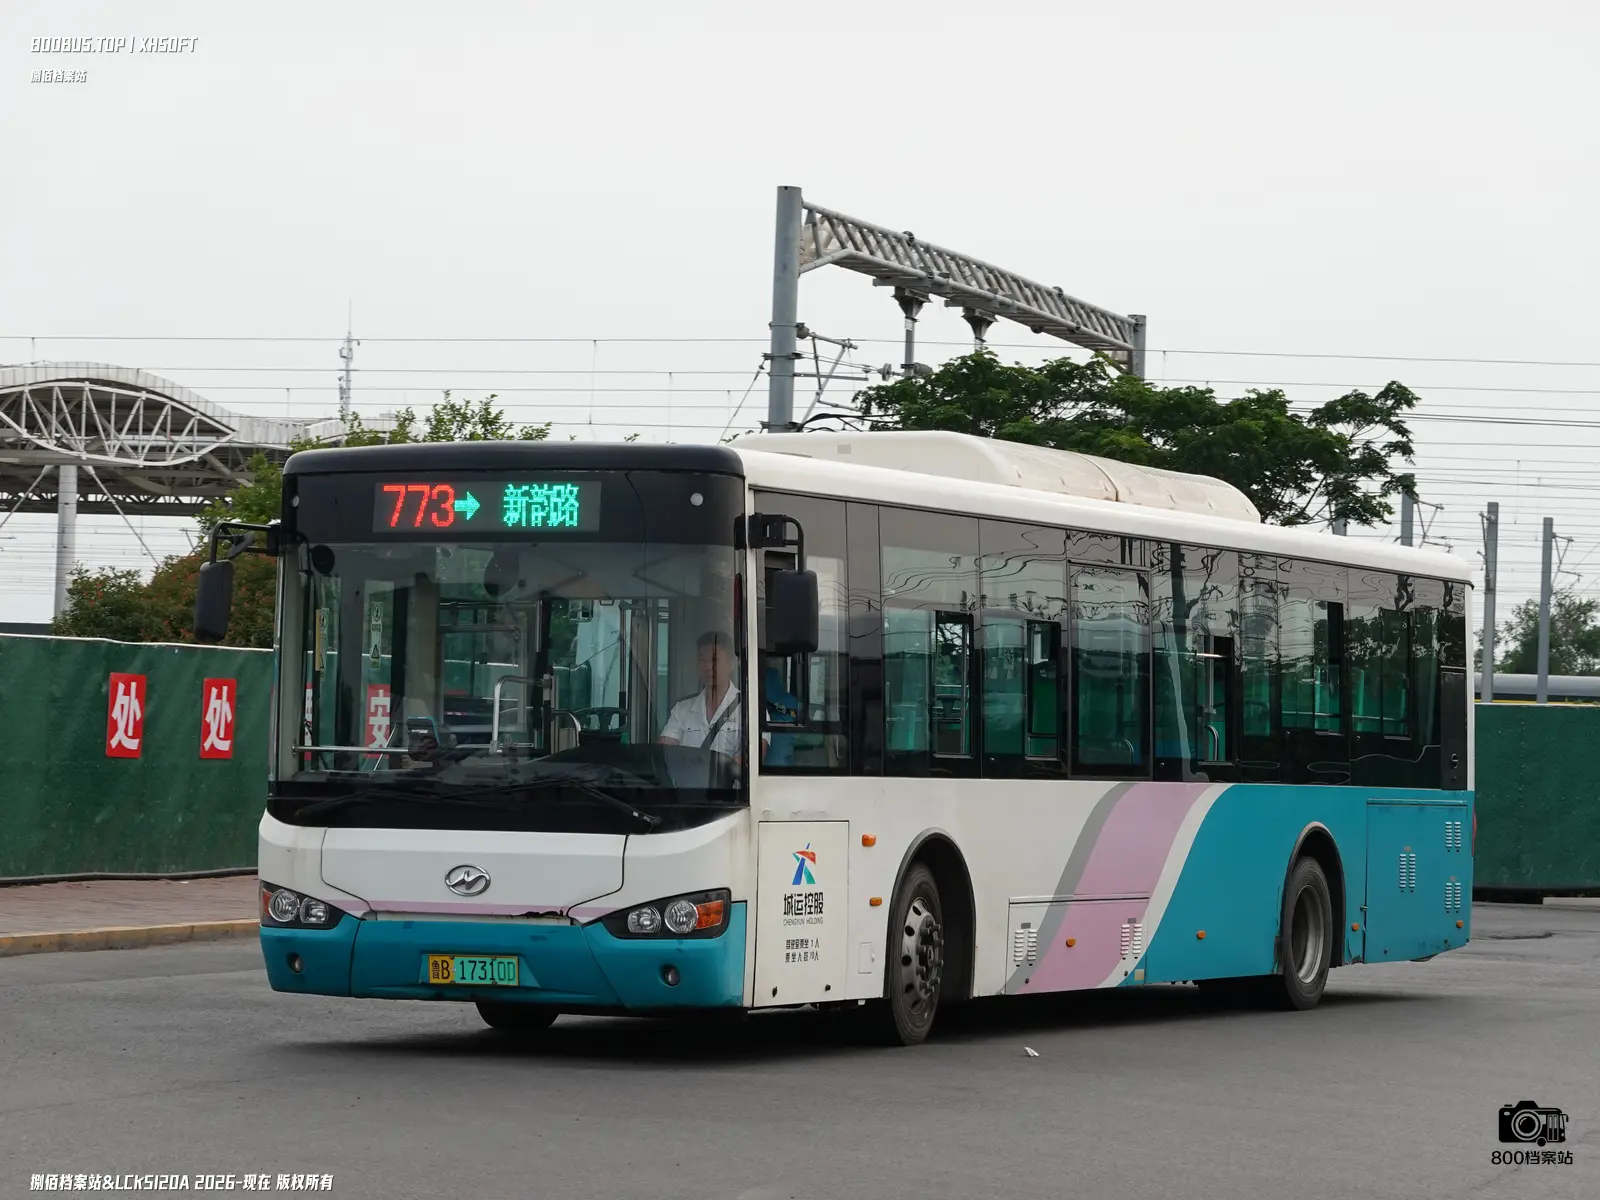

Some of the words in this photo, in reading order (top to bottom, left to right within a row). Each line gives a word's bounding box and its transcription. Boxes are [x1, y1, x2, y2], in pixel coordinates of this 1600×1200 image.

[383, 484, 455, 528] 773
[503, 483, 580, 527] 新韵路
[110, 681, 142, 750] 处
[203, 685, 232, 751] 处
[783, 892, 824, 916] 城运控股
[783, 918, 805, 927] CHENGYUN
[806, 917, 823, 925] HOLDING
